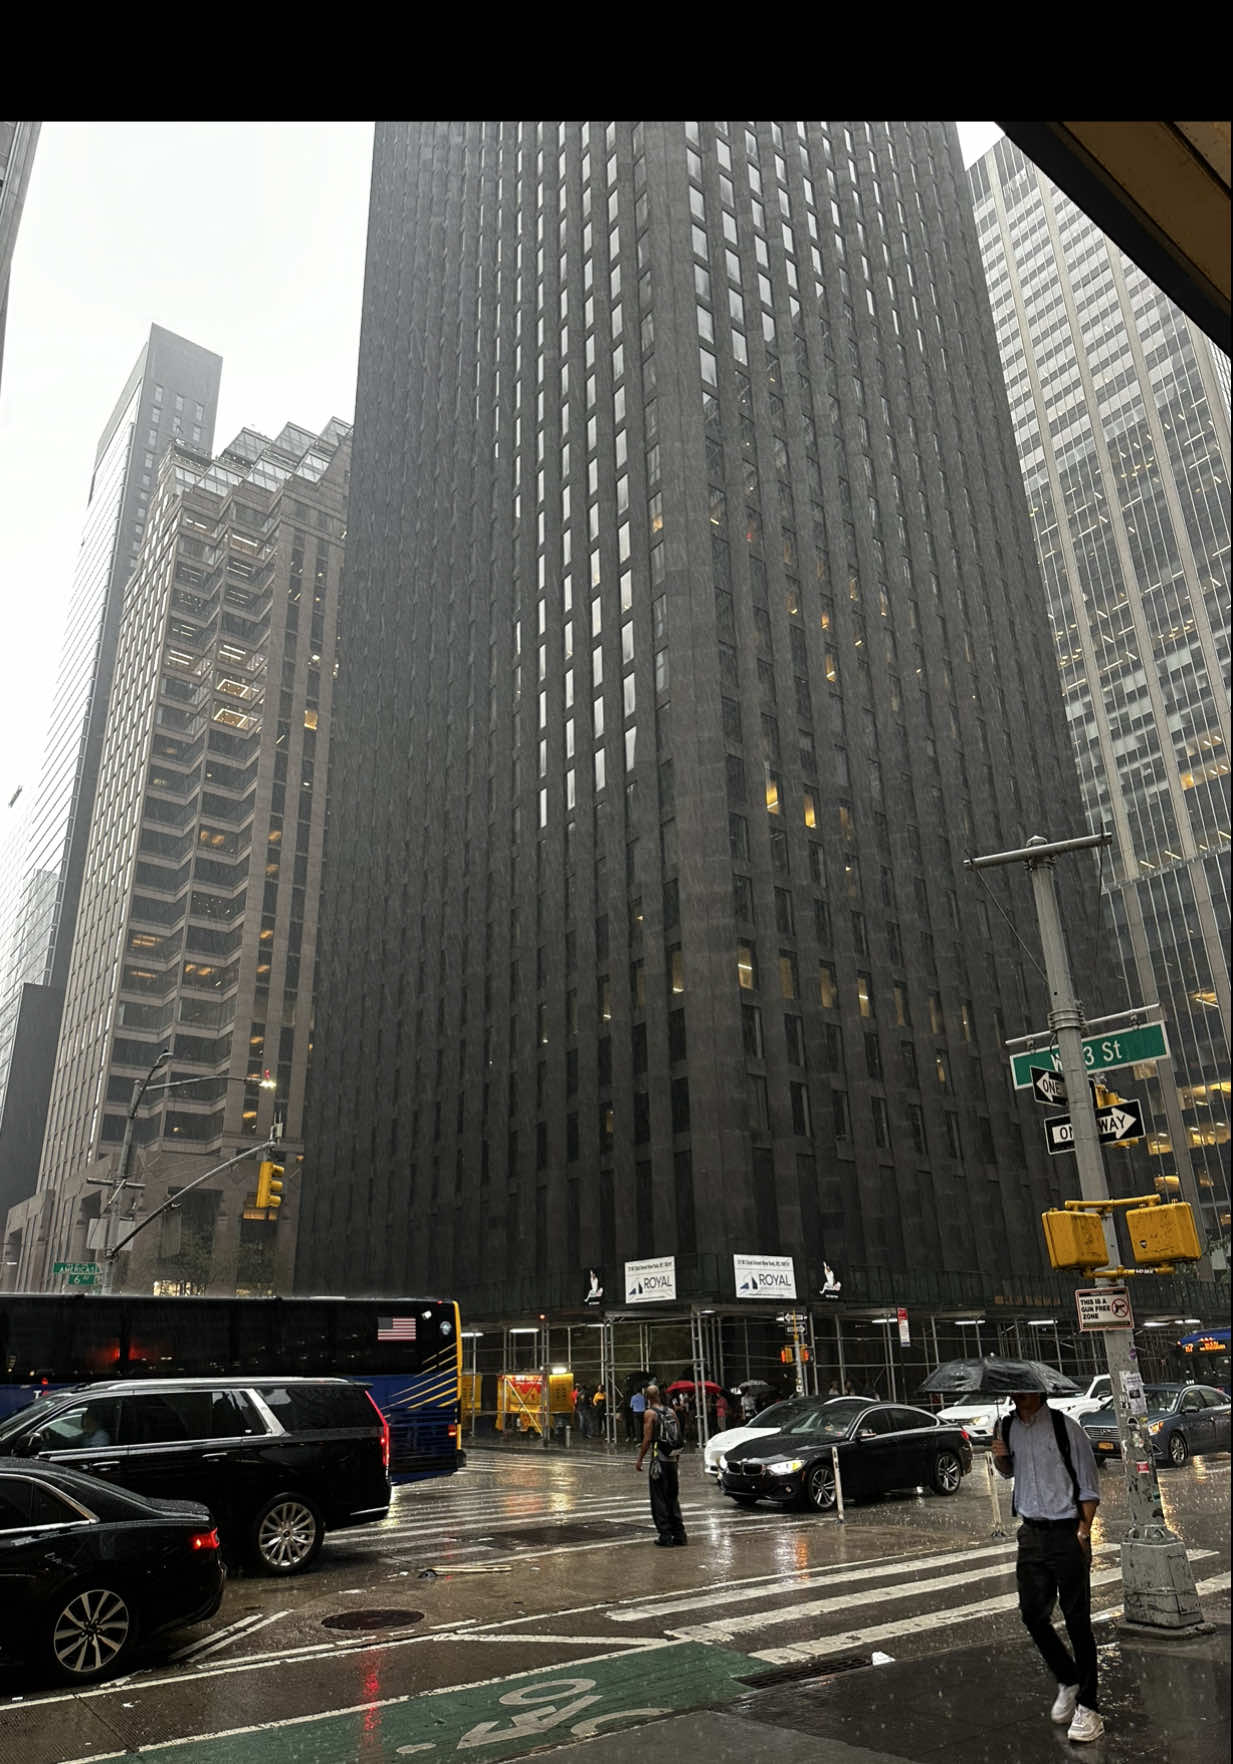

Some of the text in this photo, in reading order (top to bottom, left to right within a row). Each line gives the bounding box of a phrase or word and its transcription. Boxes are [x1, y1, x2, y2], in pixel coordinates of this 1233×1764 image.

[1082, 1046, 1095, 1065] 3
[1102, 1040, 1122, 1062] St
[1099, 1115, 1126, 1133] WAY
[643, 1275, 672, 1289] ROYAL
[759, 1273, 792, 1287] ROYAL
